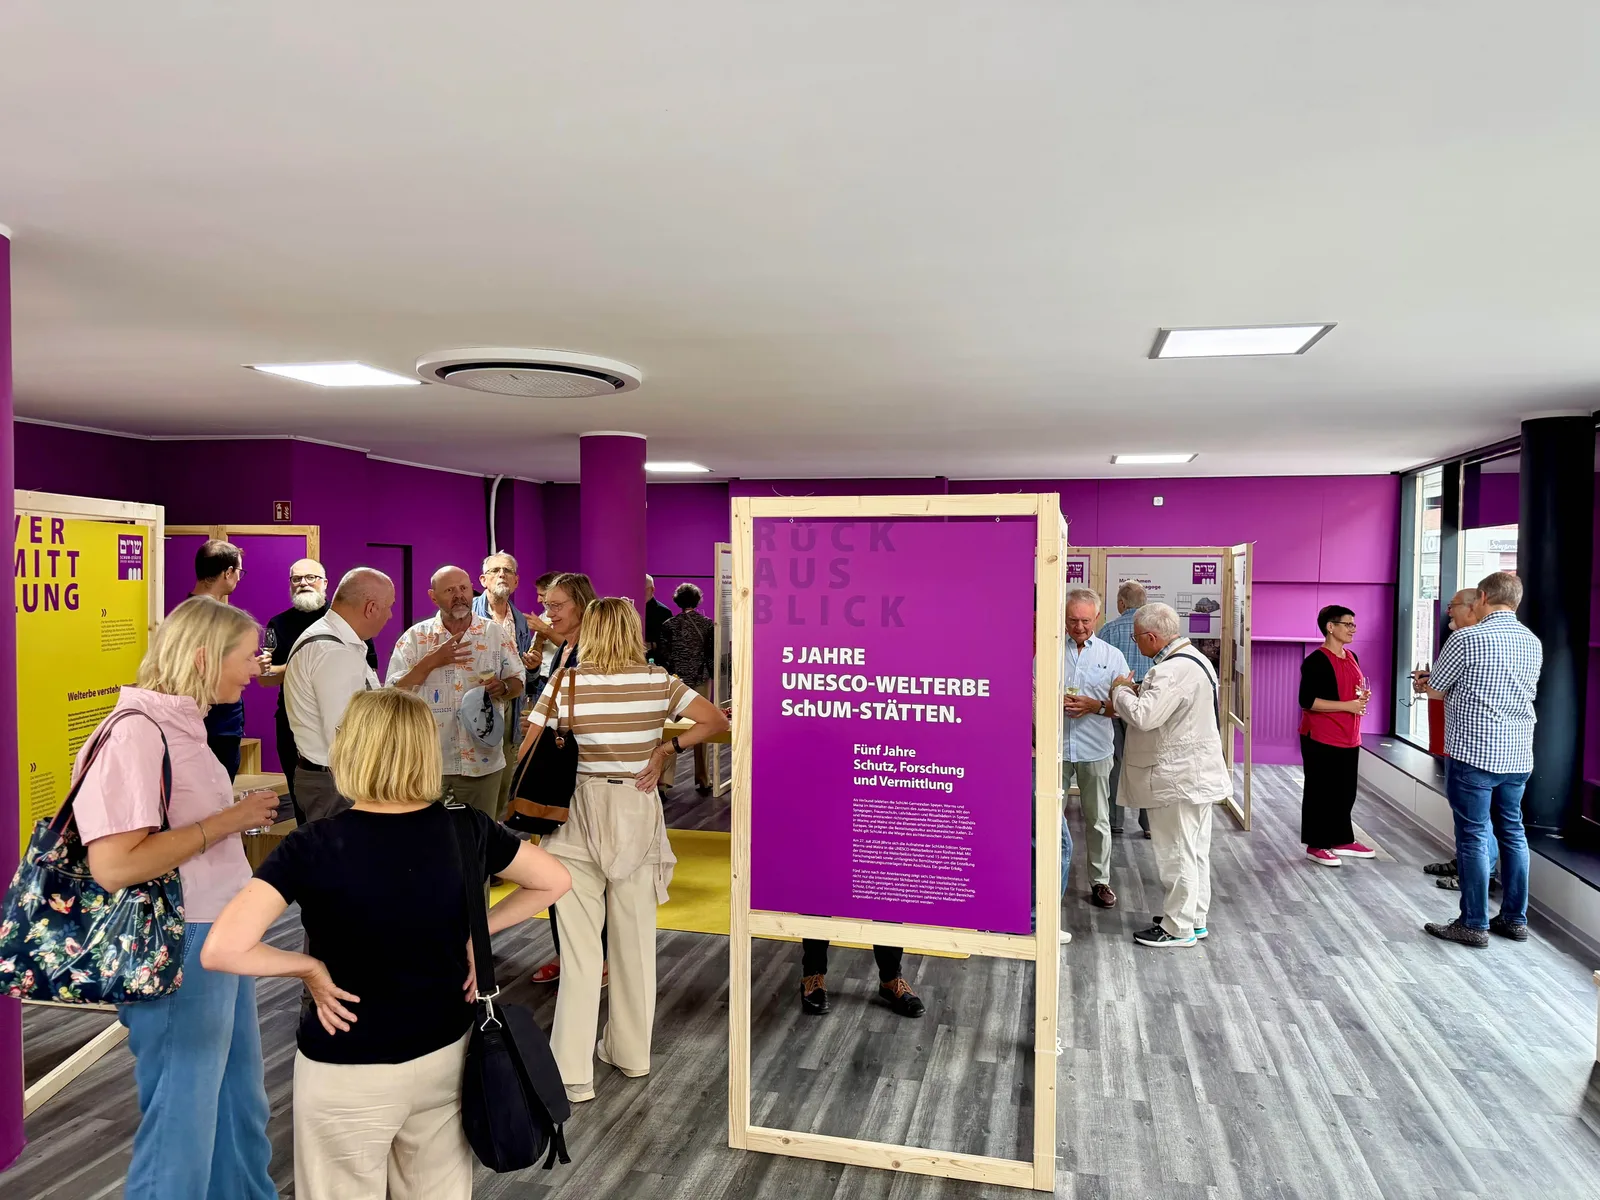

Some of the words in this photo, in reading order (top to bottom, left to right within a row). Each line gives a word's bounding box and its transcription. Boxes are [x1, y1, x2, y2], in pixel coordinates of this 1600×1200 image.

[753, 521, 897, 553] RÜCK
[754, 557, 851, 589] AUS
[15, 582, 80, 613] UNG
[754, 594, 906, 628] BLICK
[782, 646, 794, 664] 5
[798, 647, 866, 665] JAHRE
[67, 689, 96, 701] Welterbe
[782, 672, 990, 697] UNESCO-WELTERBE
[781, 699, 962, 723] SchUM-STÄTTEN.
[854, 744, 881, 756] Fünf
[883, 745, 916, 758] Jahre
[854, 759, 897, 773] Schutz,
[900, 762, 965, 778] Forschung
[854, 774, 877, 786] und
[879, 776, 953, 793] Vermittlung
